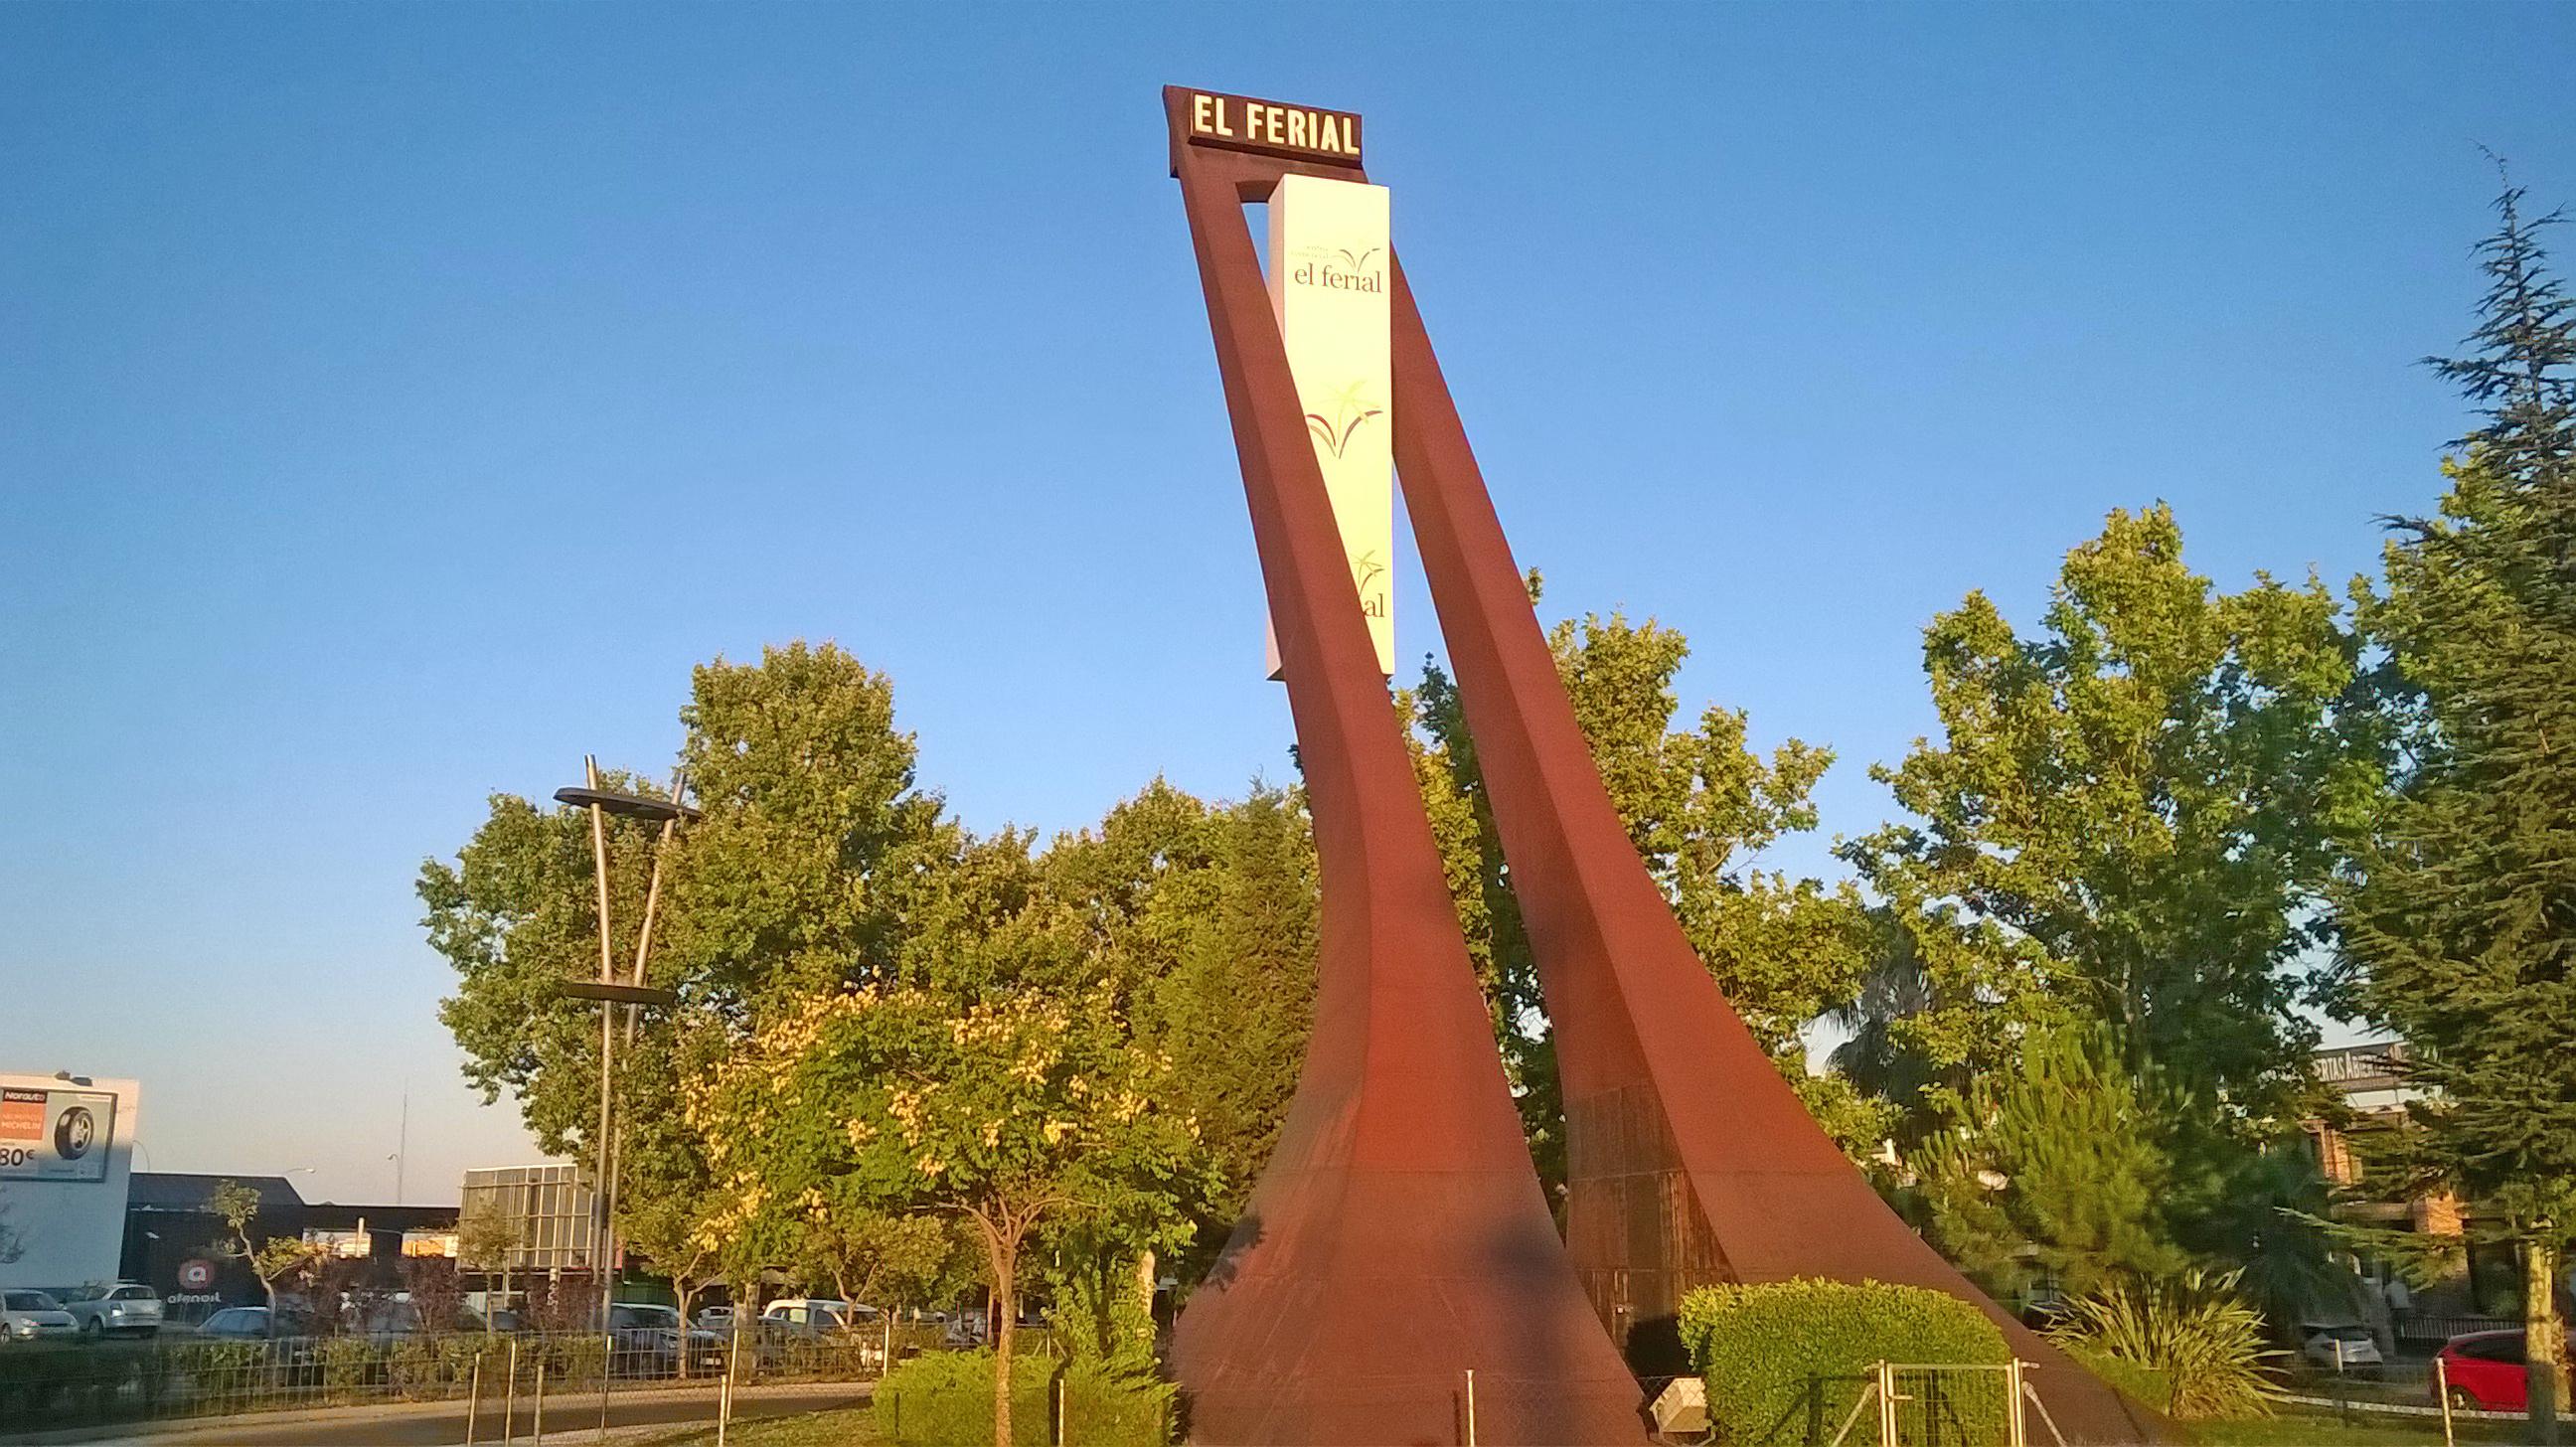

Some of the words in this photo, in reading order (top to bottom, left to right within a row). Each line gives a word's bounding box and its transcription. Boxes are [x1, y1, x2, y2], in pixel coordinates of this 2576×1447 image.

[1194, 94, 1232, 136] EL
[1246, 102, 1361, 155] FERIAL
[1295, 262, 1313, 285] el
[1322, 264, 1381, 293] ferial
